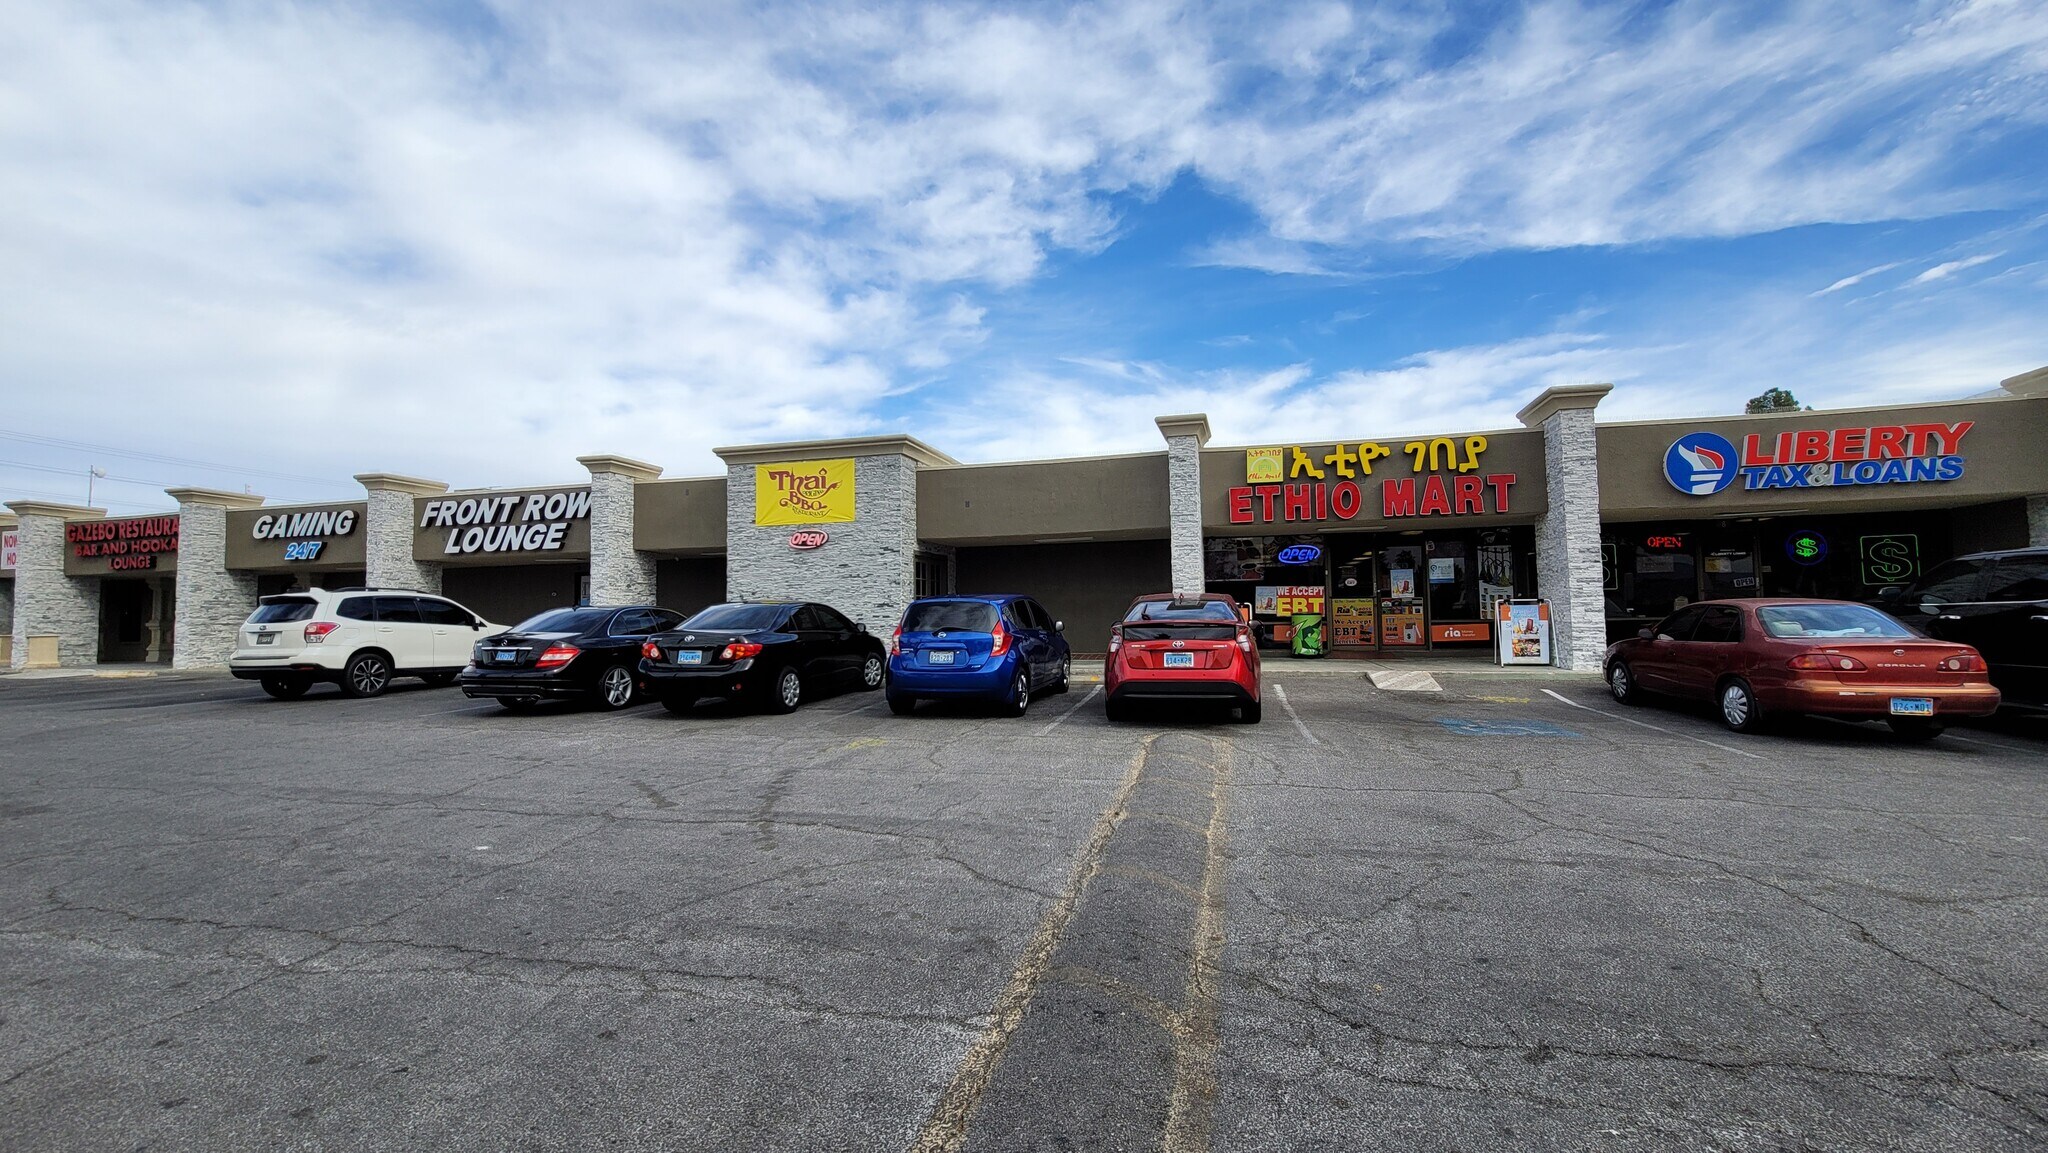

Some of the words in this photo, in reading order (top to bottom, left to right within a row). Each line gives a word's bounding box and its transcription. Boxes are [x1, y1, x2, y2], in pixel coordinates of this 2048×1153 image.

[1742, 421, 1975, 466] LIBERTY
[768, 466, 828, 490] Thai
[779, 491, 828, 511] BBQ
[1228, 480, 1362, 523] ETHIO
[1383, 473, 1516, 518] MART
[420, 496, 520, 527] FRONT
[522, 491, 592, 521] ROW
[66, 521, 116, 543] GAZEBO
[252, 509, 355, 540] GAMING
[75, 542, 99, 557] BAR
[101, 541, 128, 555] AND
[131, 537, 178, 553] HOOKA
[444, 522, 568, 554] LOUNGE
[791, 532, 825, 547] OPEN
[1648, 536, 1682, 548] OPEN
[284, 541, 322, 560] 24/7
[1281, 548, 1316, 561] OPEN
[109, 555, 151, 570] LOUNGE
[1276, 586, 1290, 596] WE
[1291, 586, 1324, 596] ACCEPT
[1735, 577, 1754, 587] OPEN
[1277, 597, 1324, 616] EBT
[1334, 627, 1357, 636] EBT
[1444, 627, 1461, 638] ria
